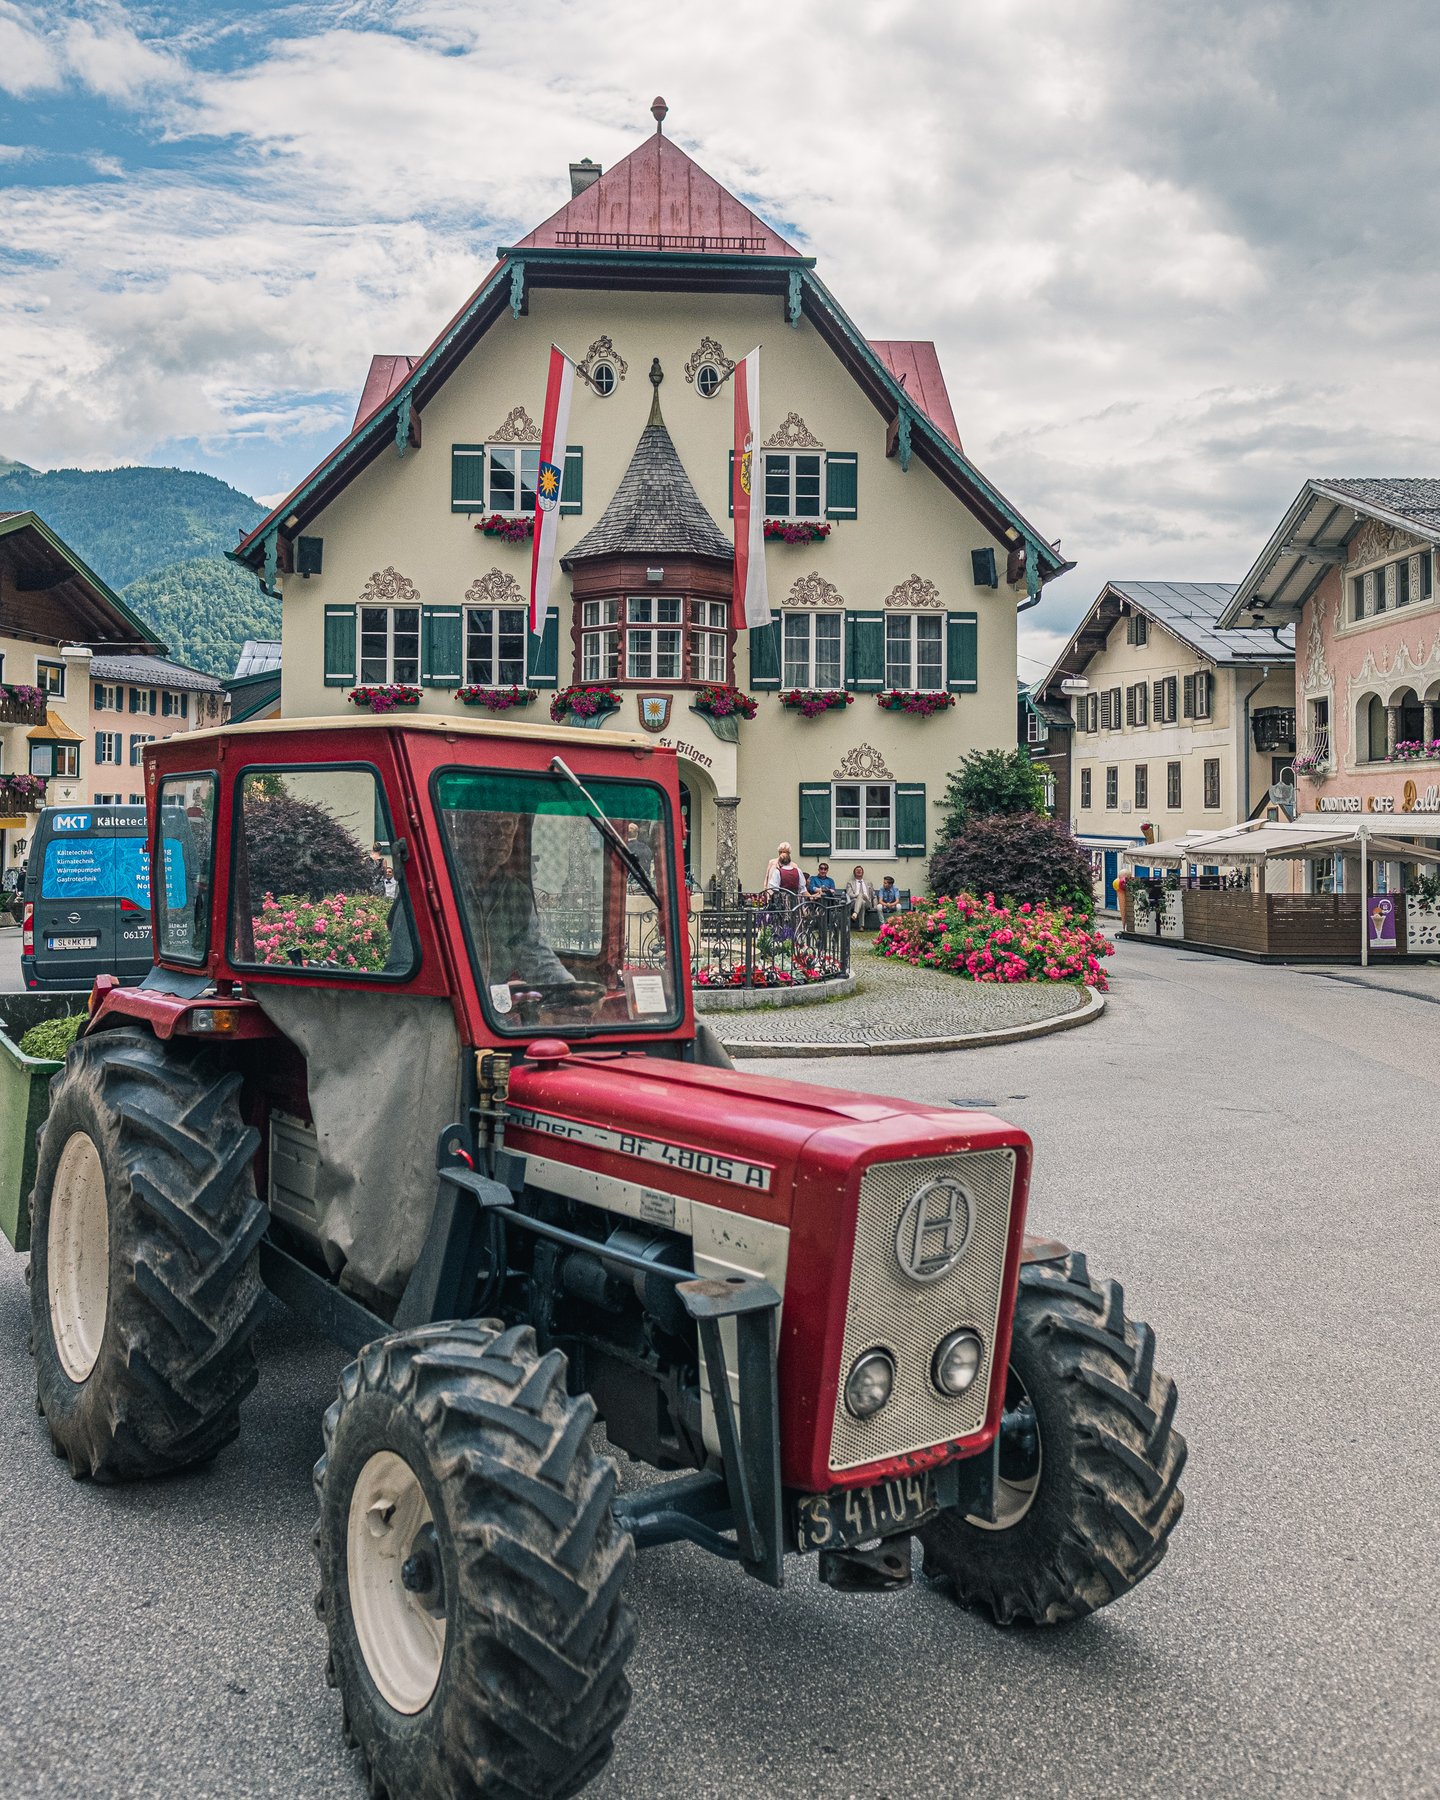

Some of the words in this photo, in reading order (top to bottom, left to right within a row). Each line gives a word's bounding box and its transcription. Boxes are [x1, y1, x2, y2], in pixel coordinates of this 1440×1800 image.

[659, 737, 672, 748] St
[676, 740, 713, 768] Gilgen
[57, 816, 87, 829] MKT
[619, 1135, 653, 1157] BF
[745, 1166, 764, 1188] A
